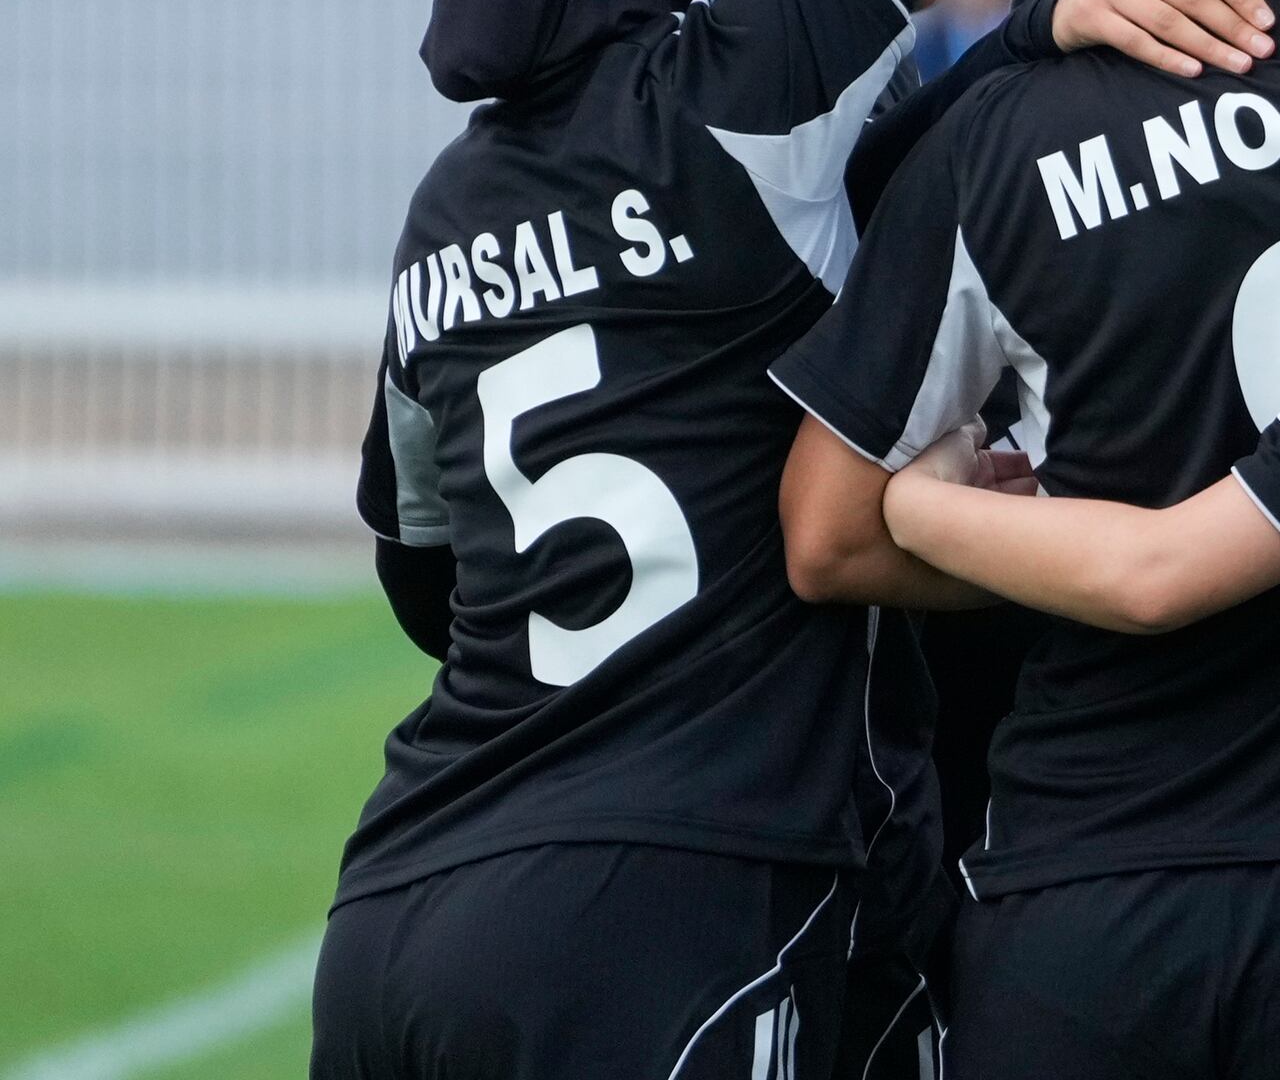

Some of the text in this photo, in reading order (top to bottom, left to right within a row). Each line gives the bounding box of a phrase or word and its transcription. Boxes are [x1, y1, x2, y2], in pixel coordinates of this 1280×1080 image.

[393, 188, 694, 369] MURSAL S.
[476, 323, 699, 687] 5
